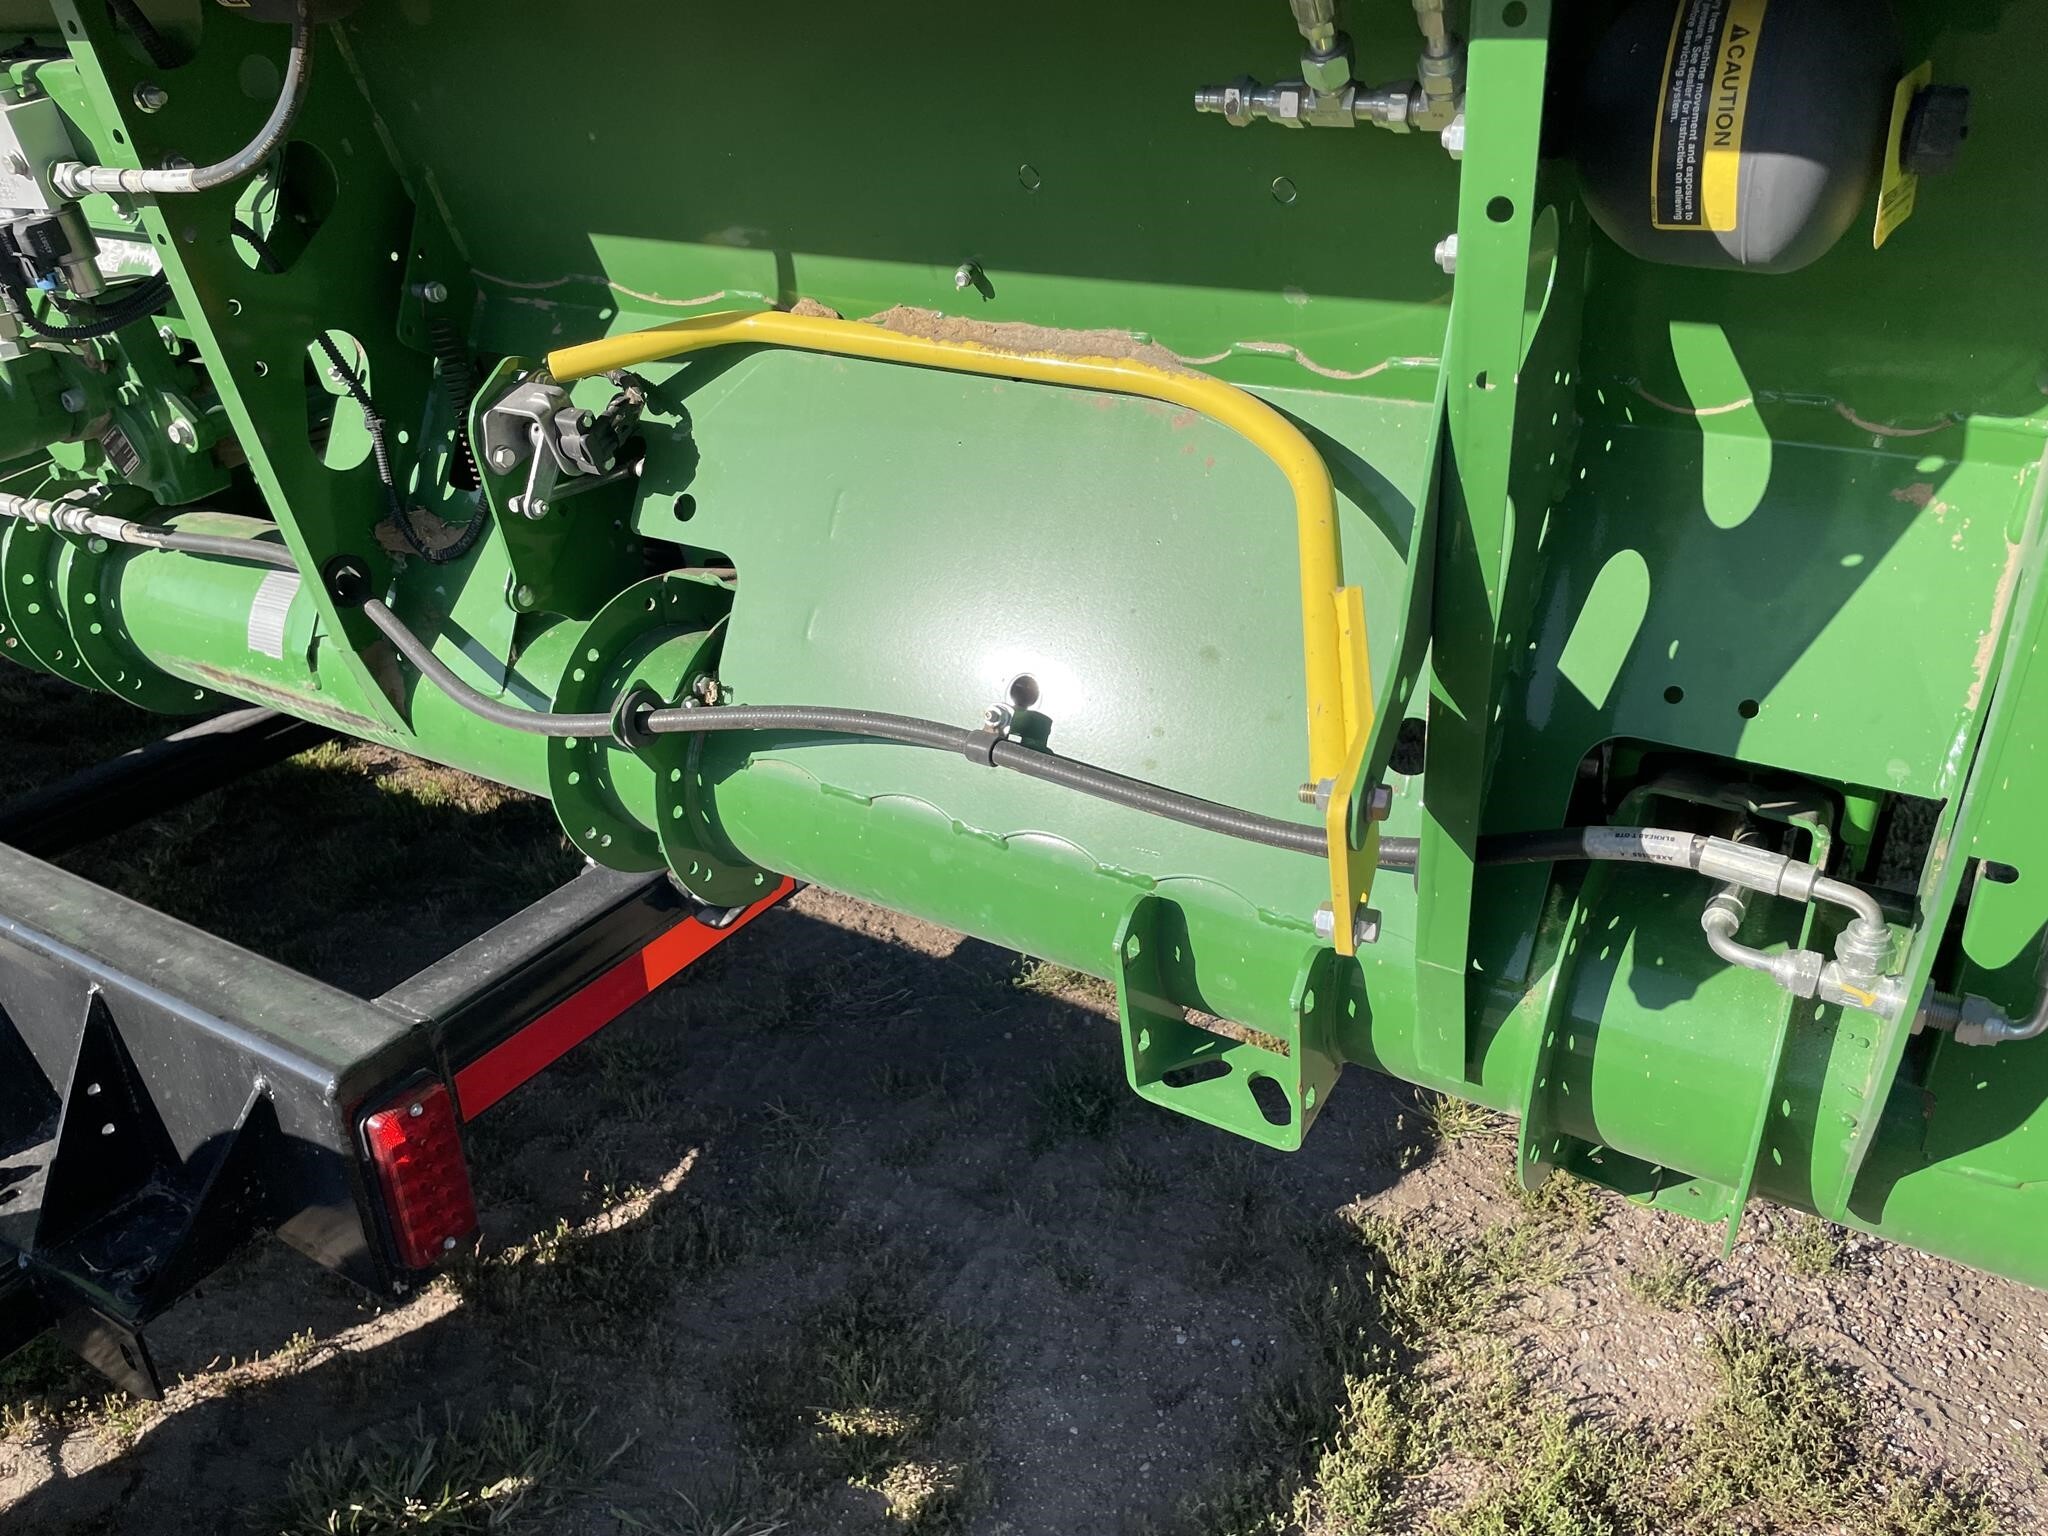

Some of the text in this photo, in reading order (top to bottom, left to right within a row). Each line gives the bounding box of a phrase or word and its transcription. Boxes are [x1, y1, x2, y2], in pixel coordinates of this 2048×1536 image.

[1707, 11, 1721, 33] from
[1675, 29, 1693, 77] servicing
[1690, 46, 1702, 64] See
[1697, 36, 1713, 80] machine
[1685, 66, 1697, 98] dealer
[1713, 44, 1746, 146] CAUTION
[1670, 79, 1684, 123] system.
[1681, 100, 1692, 115] for
[1688, 83, 1704, 140] movement
[1675, 116, 1690, 170] instruction
[1686, 143, 1696, 164] and
[1675, 171, 1683, 185] on
[1683, 166, 1694, 210] exposure
[1673, 186, 1684, 221] relieving
[1684, 211, 1694, 221] to
